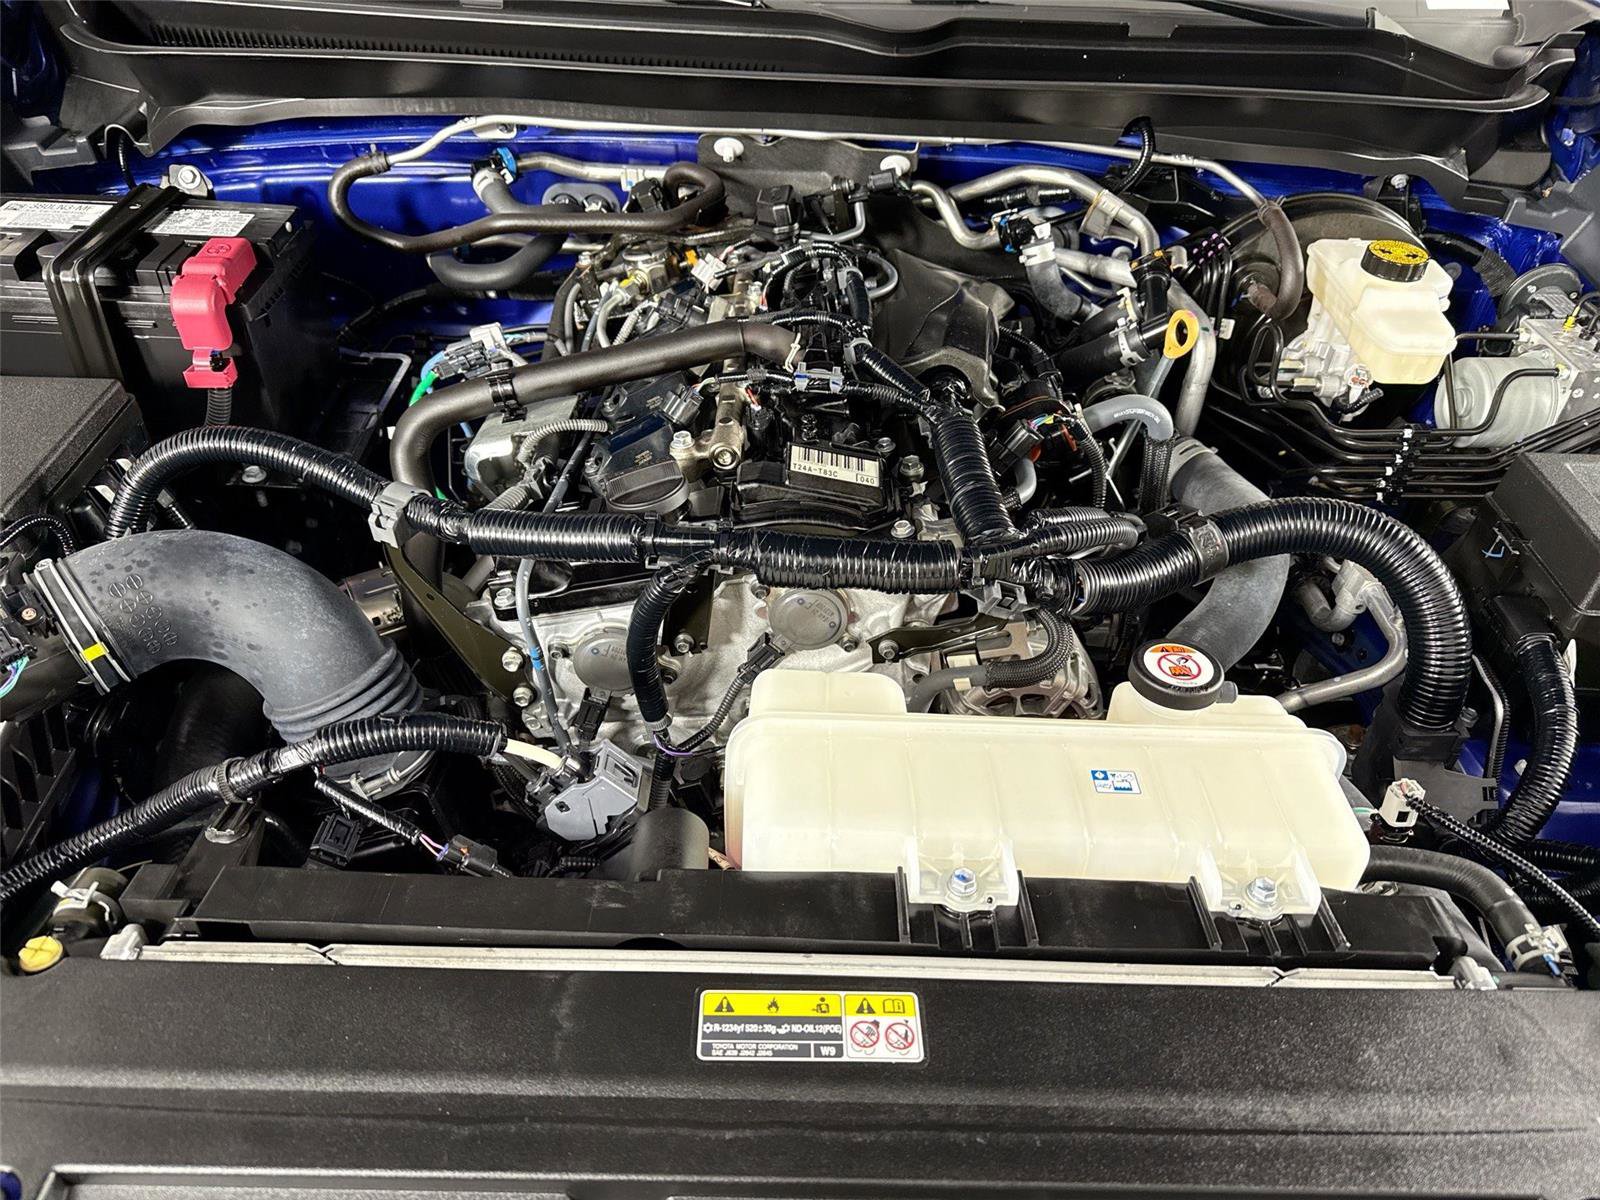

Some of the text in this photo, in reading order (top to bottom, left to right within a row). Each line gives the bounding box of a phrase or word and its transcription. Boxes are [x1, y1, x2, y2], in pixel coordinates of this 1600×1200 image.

[793, 463, 838, 478] T24A-T83C
[713, 1024, 744, 1034] R-1234yf
[819, 1046, 836, 1057] W9
